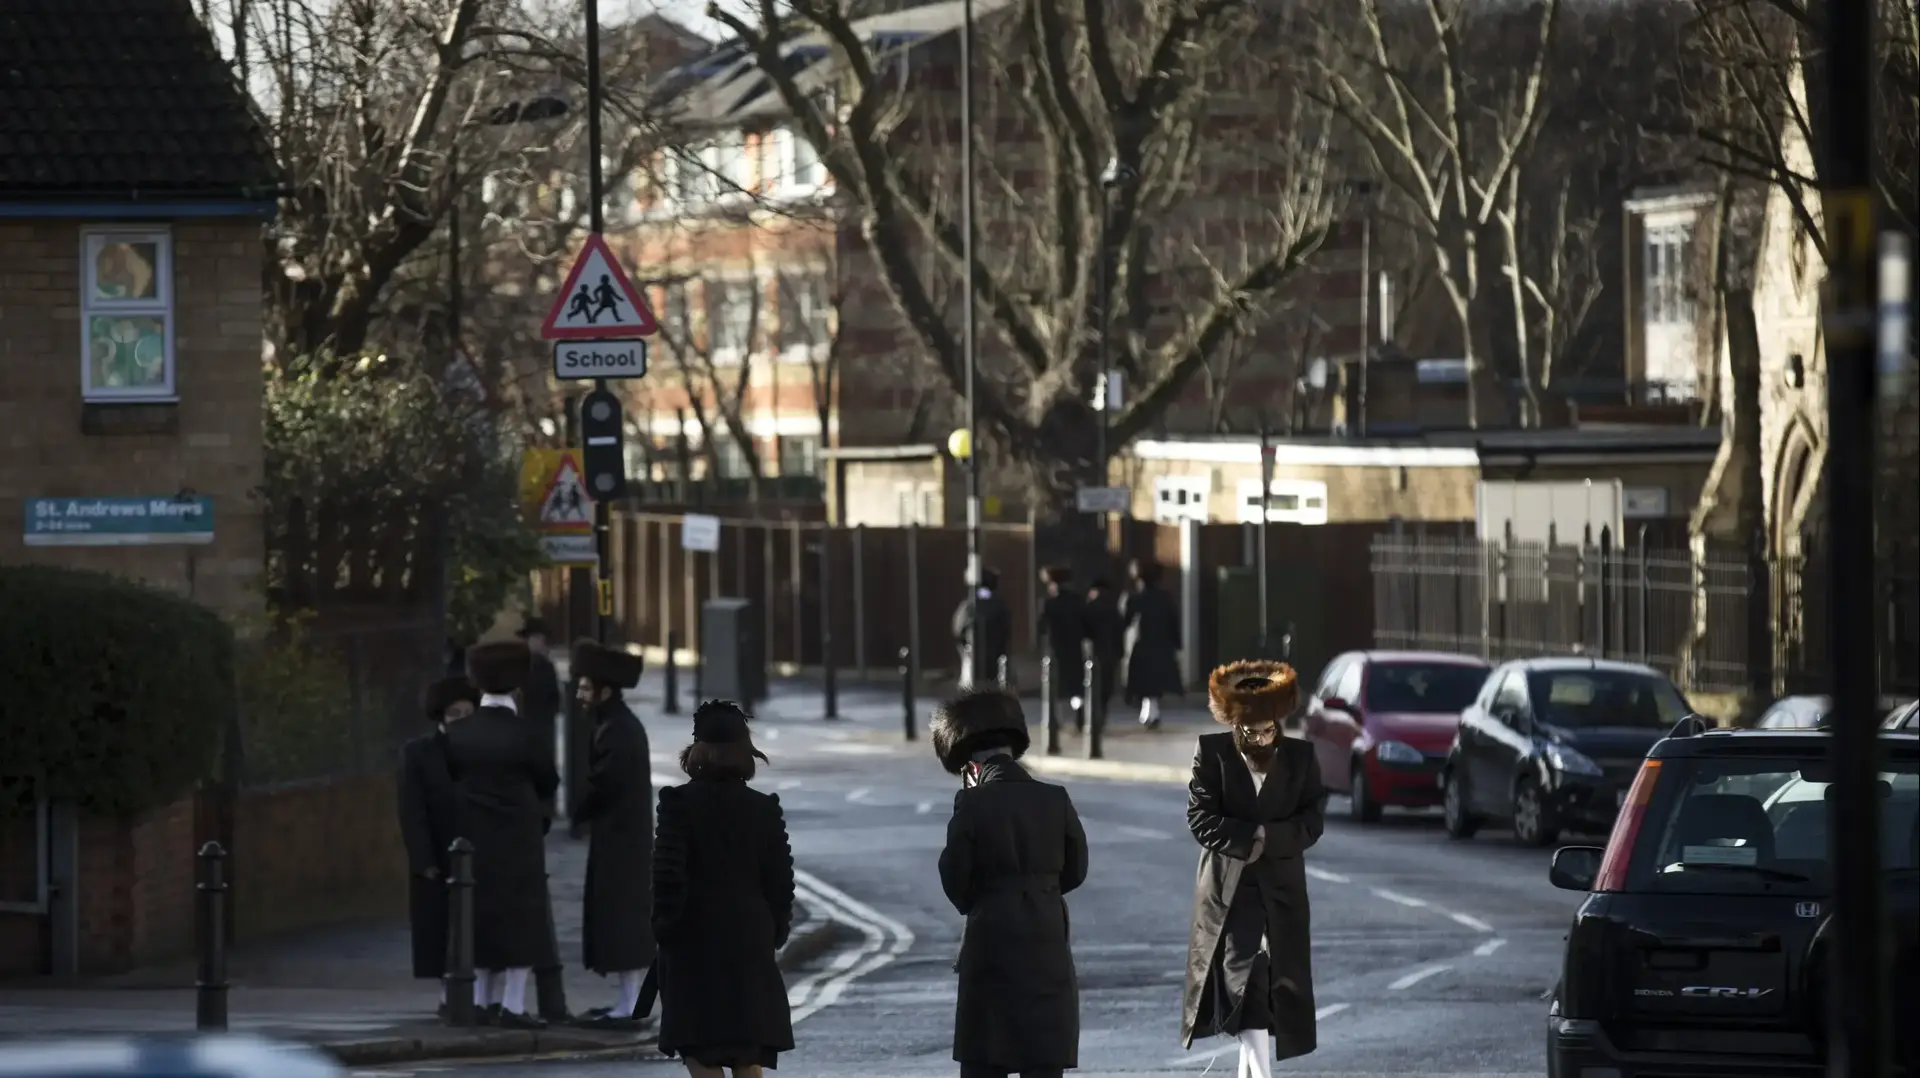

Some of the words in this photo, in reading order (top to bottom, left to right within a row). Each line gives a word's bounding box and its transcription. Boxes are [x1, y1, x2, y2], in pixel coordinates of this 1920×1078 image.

[565, 349, 636, 368] School
[35, 501, 61, 517] St.
[66, 501, 146, 517] Andrews
[1634, 988, 1674, 997] HONDA
[1681, 986, 1775, 998] CR-V
